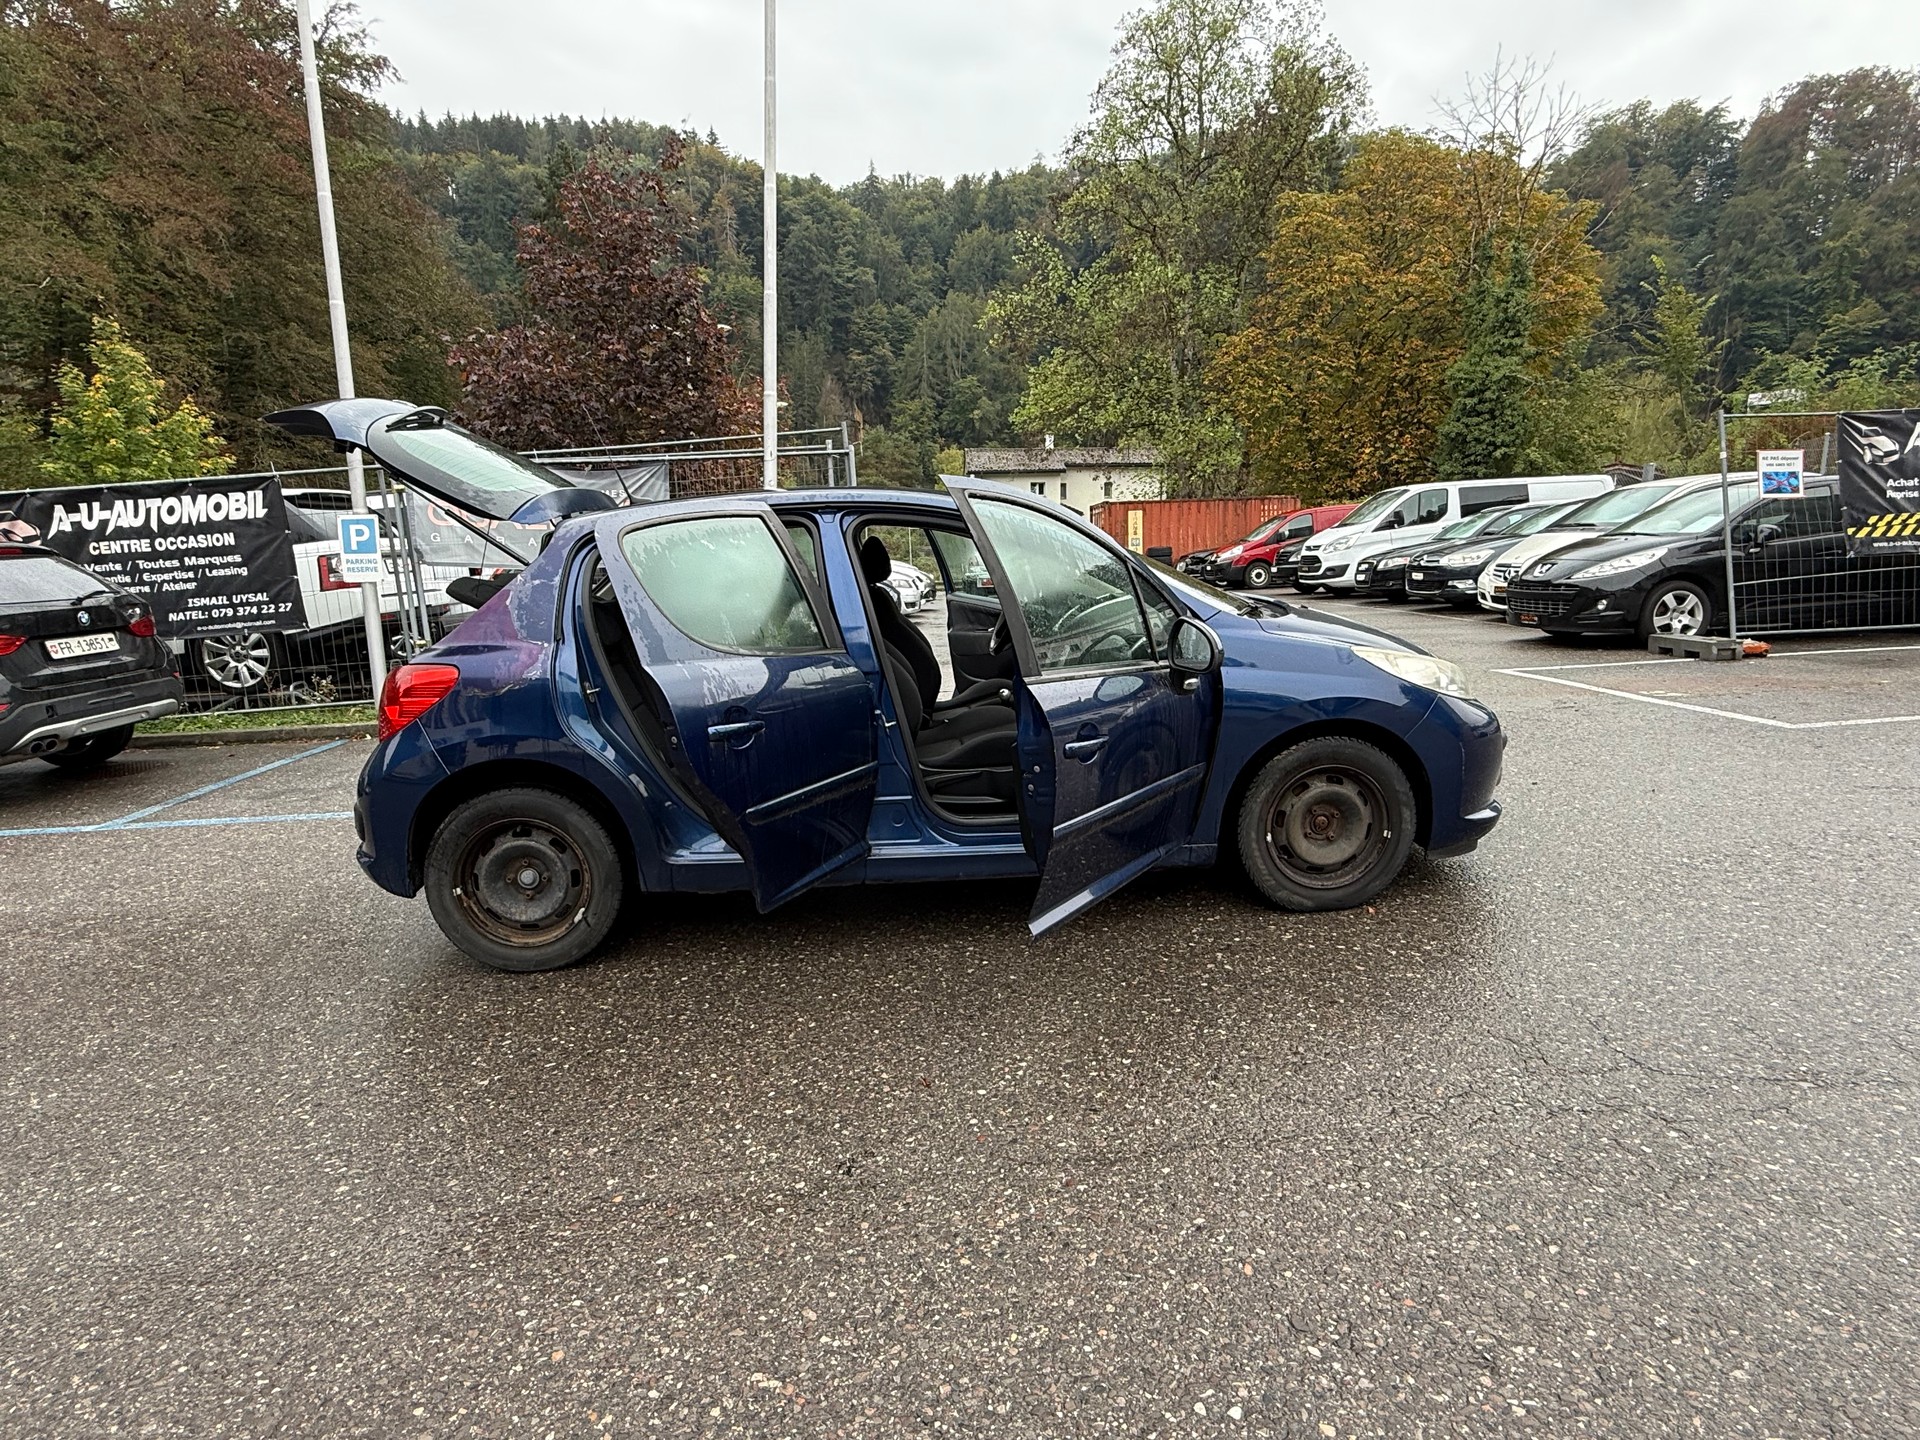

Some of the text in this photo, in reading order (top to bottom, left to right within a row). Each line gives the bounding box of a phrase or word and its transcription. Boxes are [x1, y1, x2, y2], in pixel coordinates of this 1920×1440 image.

[1886, 477, 1920, 487] Achat
[1886, 489, 1920, 499] Reprise
[47, 490, 268, 540] A-U-AUTOMOBIL
[89, 532, 236, 555] CENTRE OCCASION
[349, 524, 370, 551] P
[83, 562, 123, 572] Vente
[136, 558, 180, 570] Toutes
[184, 554, 242, 566] Marques
[346, 558, 378, 566] PARKING
[143, 570, 195, 583] Expertise
[205, 566, 248, 577] Leasing
[162, 581, 197, 592] Atelier
[188, 592, 269, 608] ISMAIL UYSAL
[168, 602, 293, 622] NATEL: 079 374 22 27
